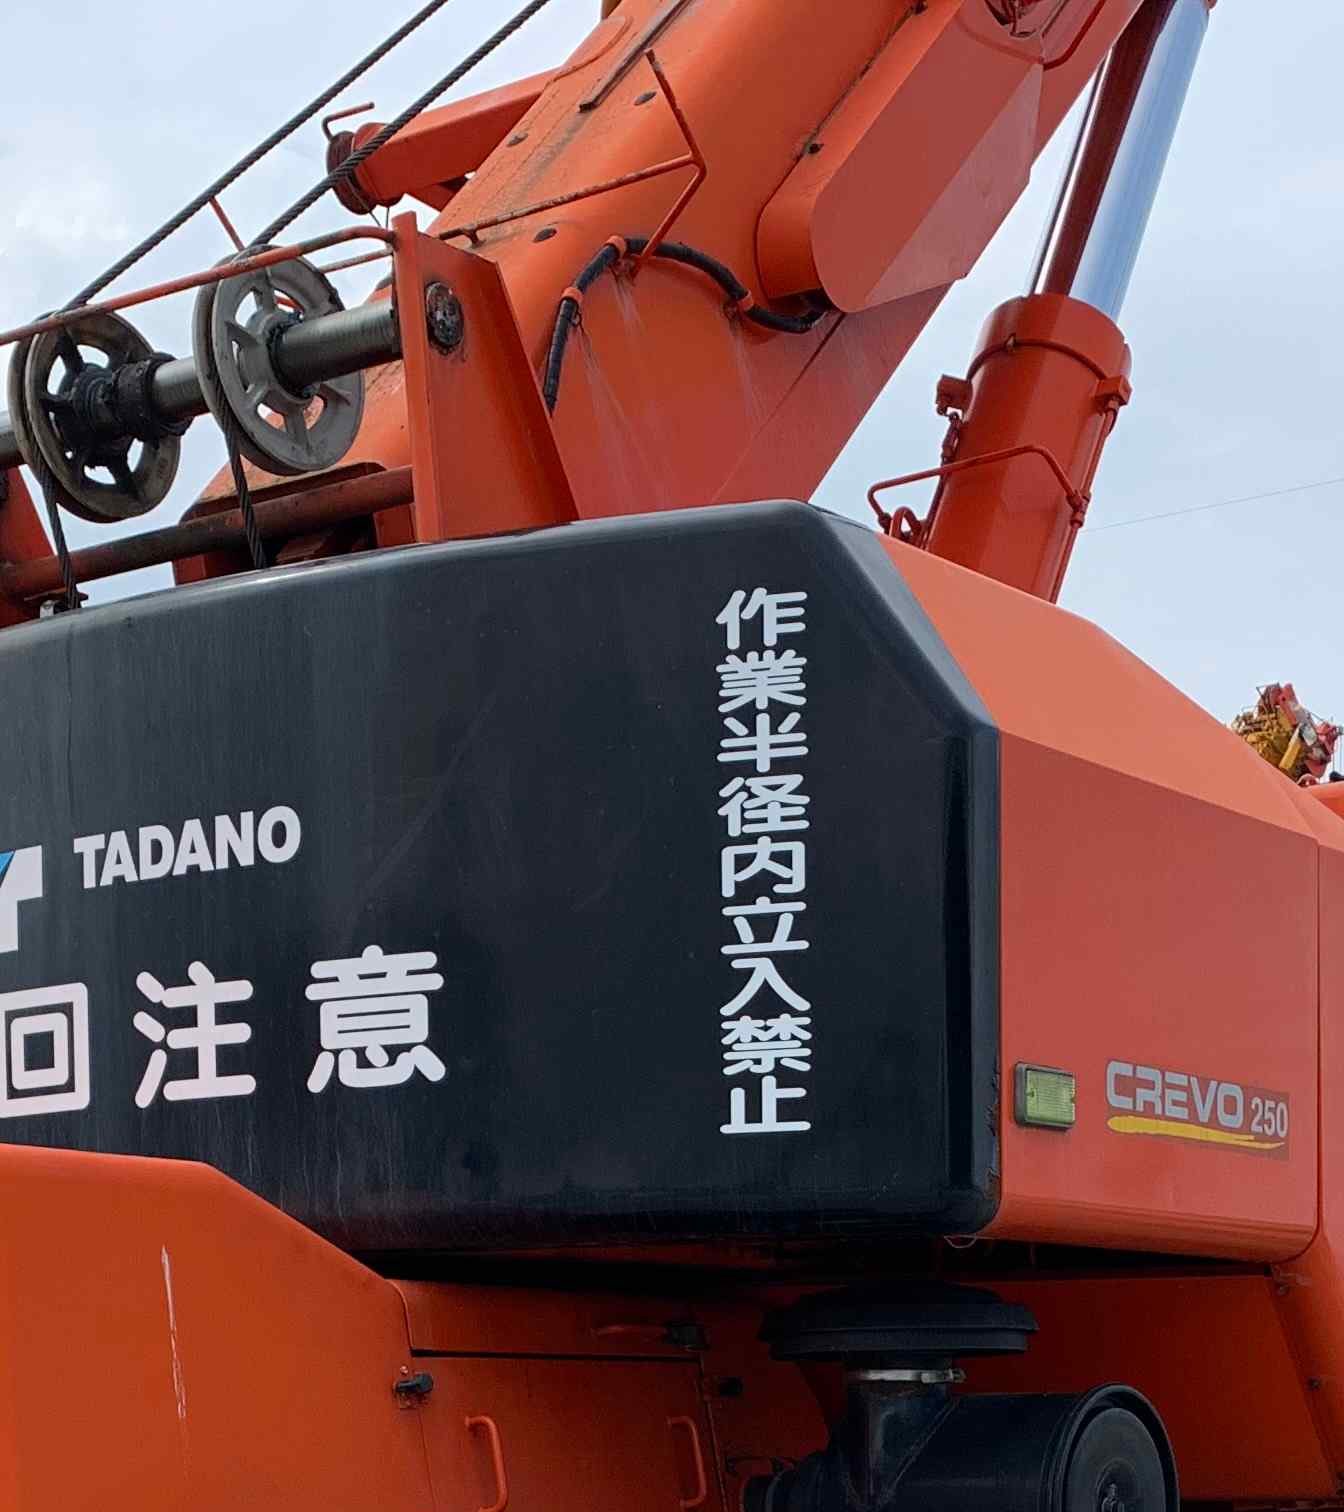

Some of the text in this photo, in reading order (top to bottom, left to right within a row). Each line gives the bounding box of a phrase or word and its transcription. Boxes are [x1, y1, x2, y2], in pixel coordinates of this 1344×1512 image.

[73, 805, 302, 890] TADANO
[716, 587, 811, 1134] 作業半径内立入禁止
[1107, 1060, 1289, 1138] CREVO 250
